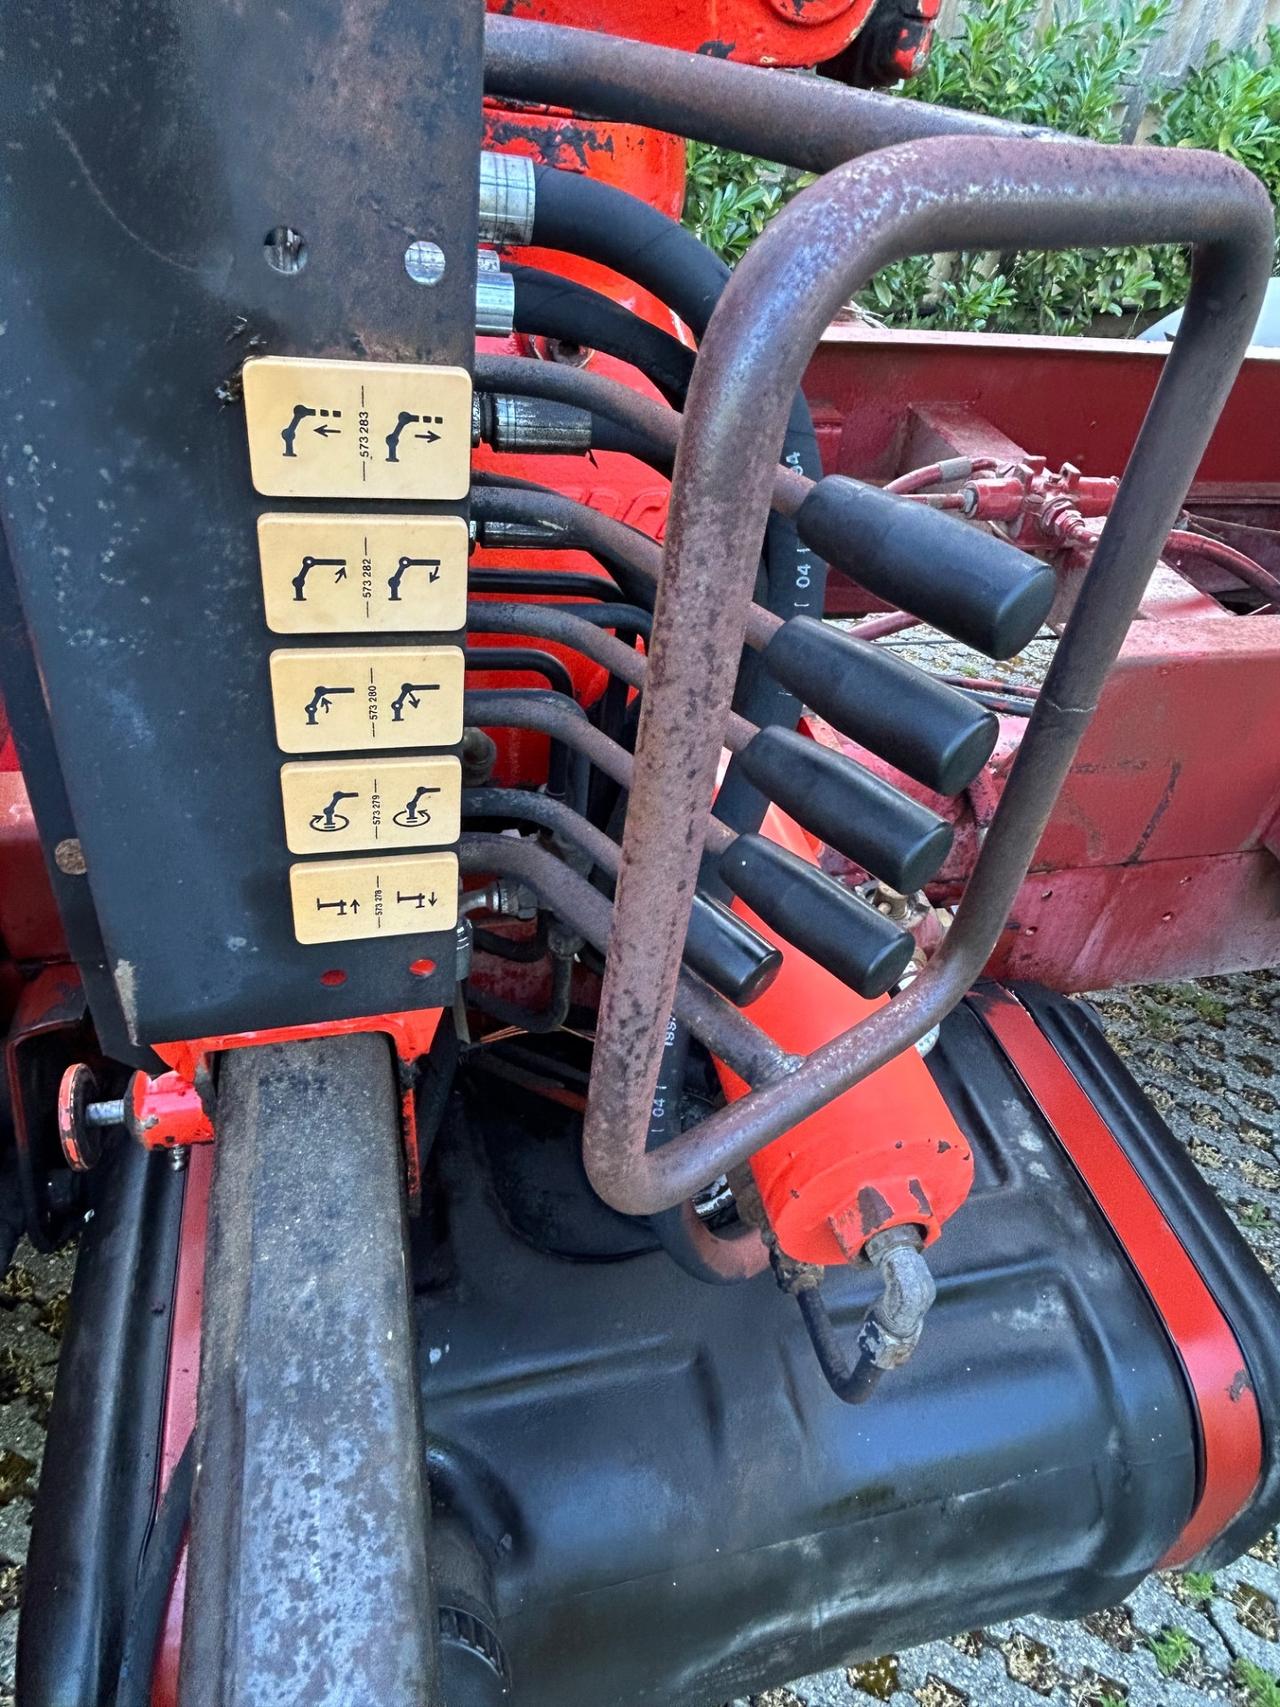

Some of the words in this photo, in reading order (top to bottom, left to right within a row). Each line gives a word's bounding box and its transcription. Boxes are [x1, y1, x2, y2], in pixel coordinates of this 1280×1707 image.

[359, 411, 369, 434] 283
[359, 436, 369, 458] 573
[362, 558, 372, 577] 282
[796, 563, 811, 588] 04
[362, 580, 372, 598] 573
[368, 685, 377, 703] 280
[368, 704, 378, 720] 573
[371, 794, 381, 809] 279
[372, 810, 381, 825] 573
[375, 903, 383, 915] 573
[652, 1098, 666, 1118] 04
